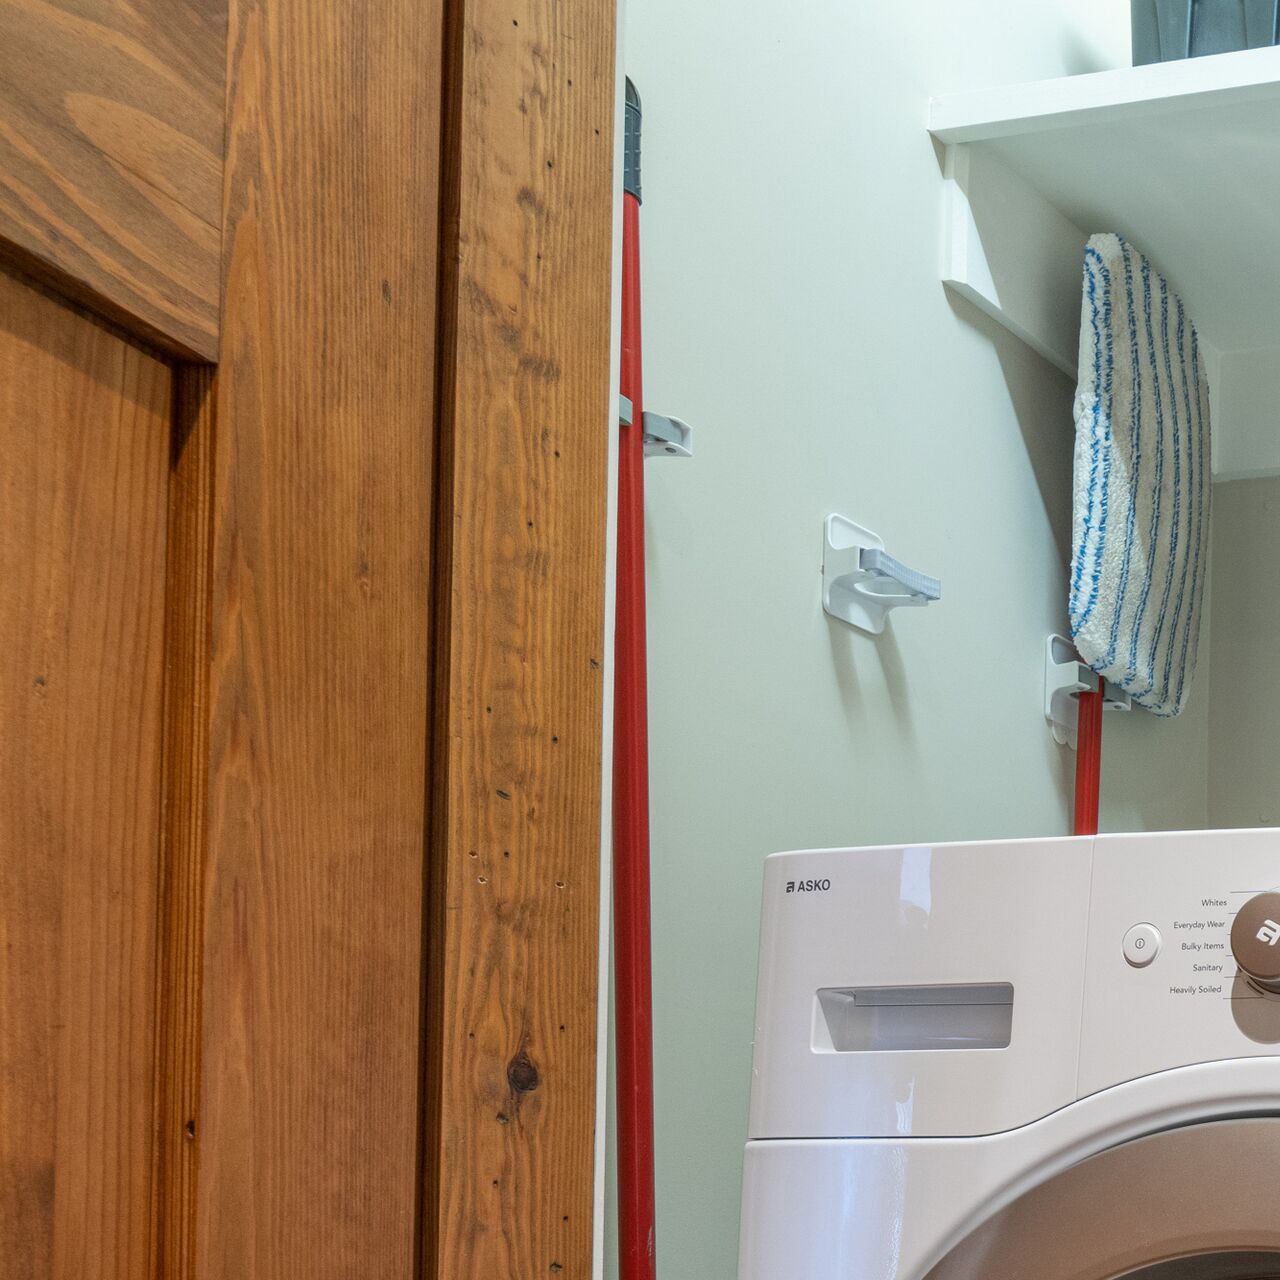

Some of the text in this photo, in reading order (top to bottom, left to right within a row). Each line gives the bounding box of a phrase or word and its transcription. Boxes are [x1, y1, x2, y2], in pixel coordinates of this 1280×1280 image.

[797, 879, 831, 892] ASKO
[1201, 899, 1228, 907] Whites
[1173, 920, 1225, 930] Everyday Wear
[1181, 942, 1225, 952] Bulky Items
[1192, 964, 1223, 973] Sanitary
[1169, 985, 1222, 995] Heavily Soiled
